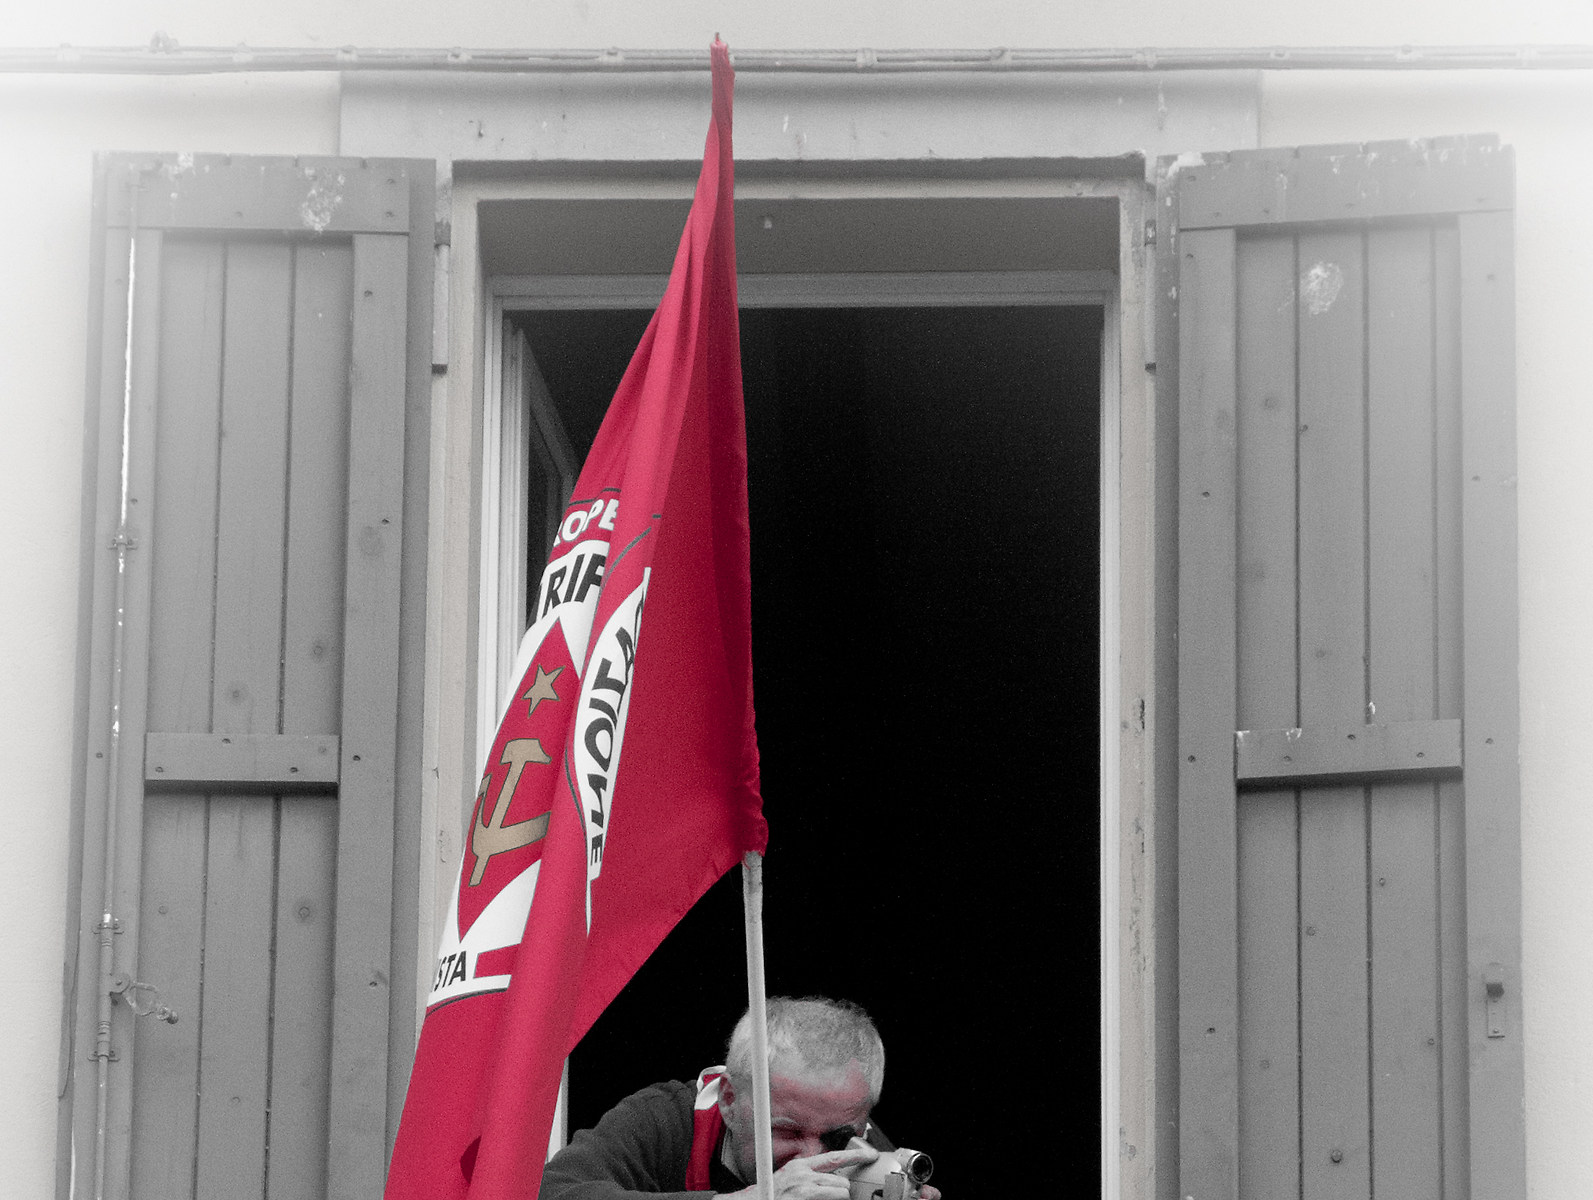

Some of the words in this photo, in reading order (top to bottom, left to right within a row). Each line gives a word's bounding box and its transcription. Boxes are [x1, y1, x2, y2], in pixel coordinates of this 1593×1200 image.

[541, 553, 607, 619] RIF
[584, 592, 643, 867] AZIONE
[431, 950, 467, 993] STA
